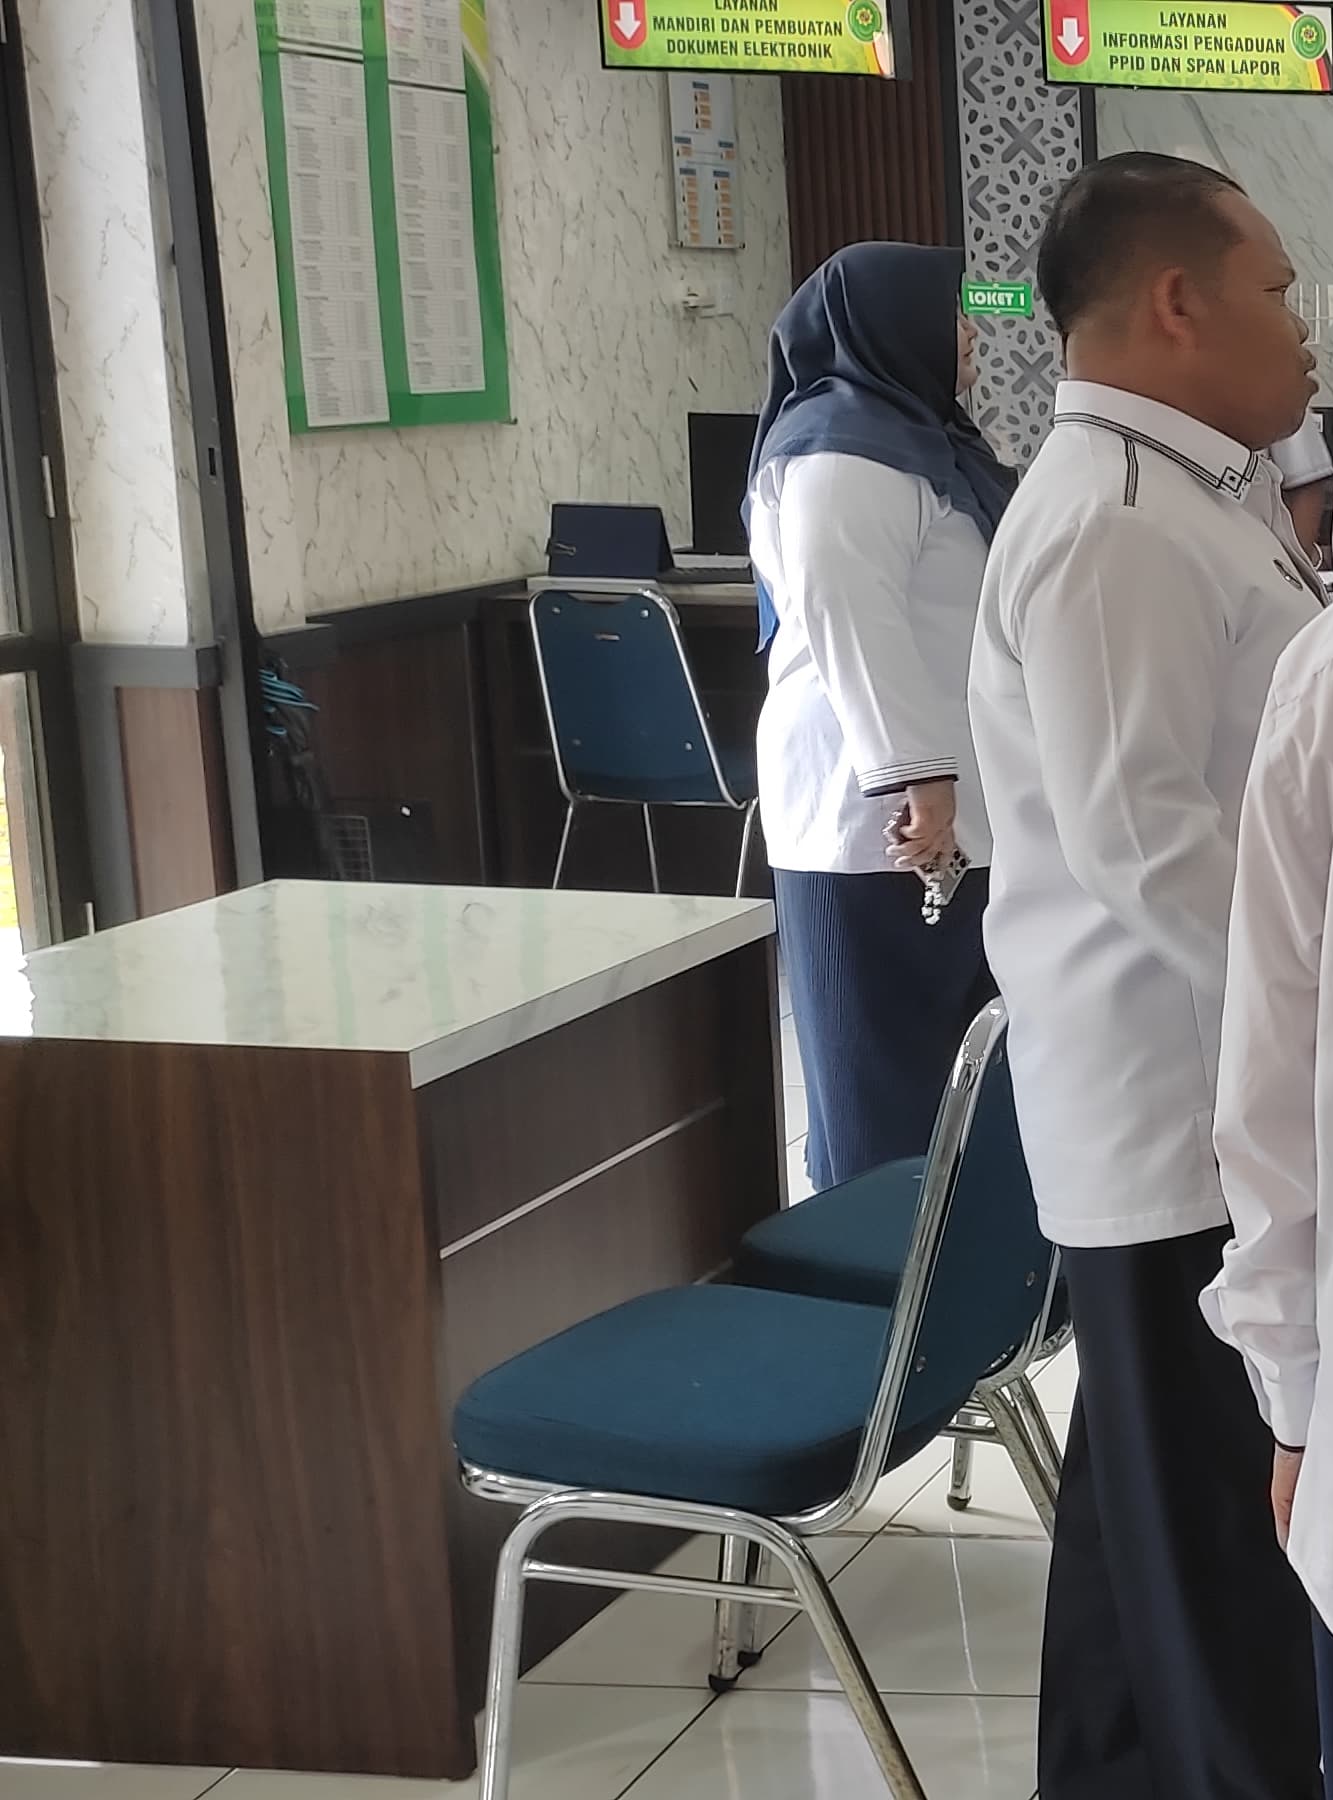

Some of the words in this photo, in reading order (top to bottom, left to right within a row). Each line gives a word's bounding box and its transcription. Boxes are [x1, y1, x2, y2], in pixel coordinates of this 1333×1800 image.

[714, 0, 779, 12] LAYANAN
[653, 16, 716, 33] MANDIRI
[721, 18, 750, 34] DAN
[755, 19, 843, 36] PEMBUATAN
[1160, 11, 1227, 29] LAYANAN
[667, 39, 739, 56] DOKUMEN
[744, 42, 833, 59] ELEKTRONIK
[1103, 32, 1188, 50] INFORMASI
[1194, 36, 1285, 53] PENGADUAN
[1109, 55, 1145, 70] PPID
[1151, 57, 1181, 72] DAN
[1187, 58, 1225, 74] SPAN
[1231, 60, 1281, 76] LAPOR
[969, 291, 1014, 306] LOKET
